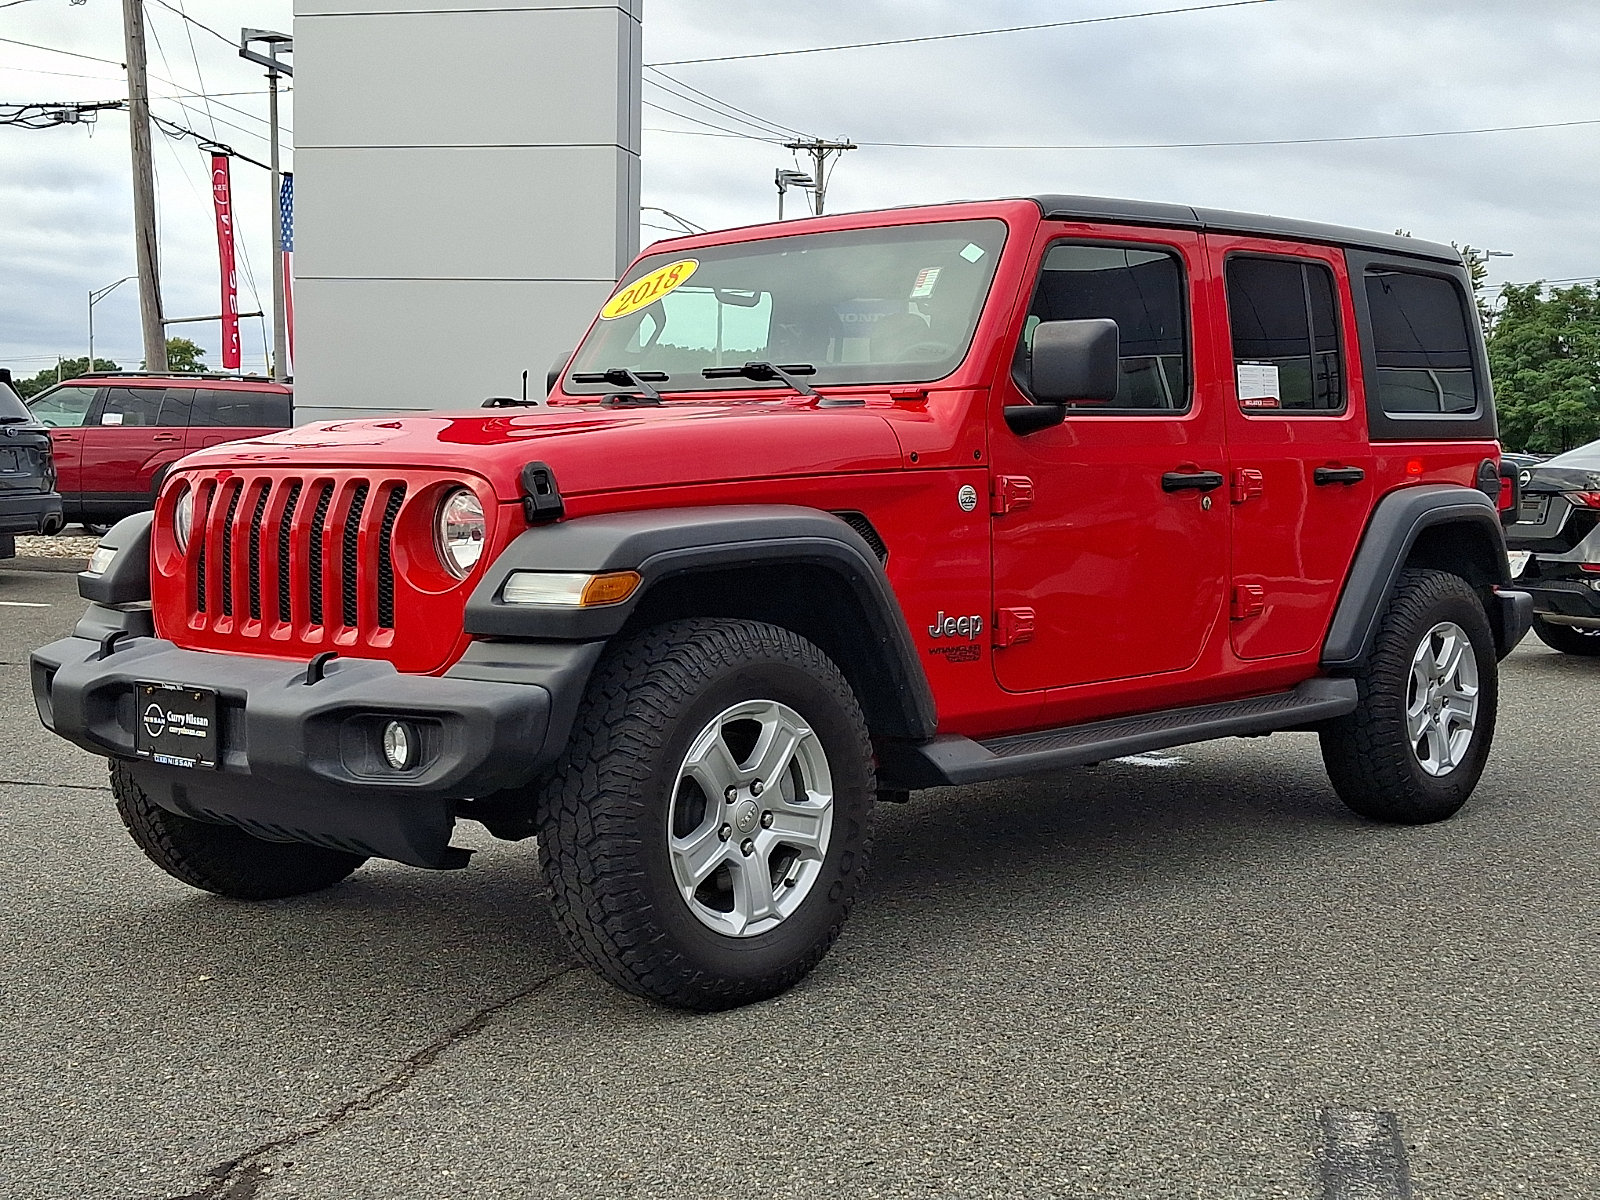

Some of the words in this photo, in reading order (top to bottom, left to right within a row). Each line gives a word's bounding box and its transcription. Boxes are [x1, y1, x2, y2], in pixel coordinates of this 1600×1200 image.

[615, 264, 683, 314] 2018
[928, 610, 982, 640] Jeep
[167, 711, 185, 726] Curry
[186, 713, 208, 726] Nissan
[167, 757, 193, 768] NISSAN
